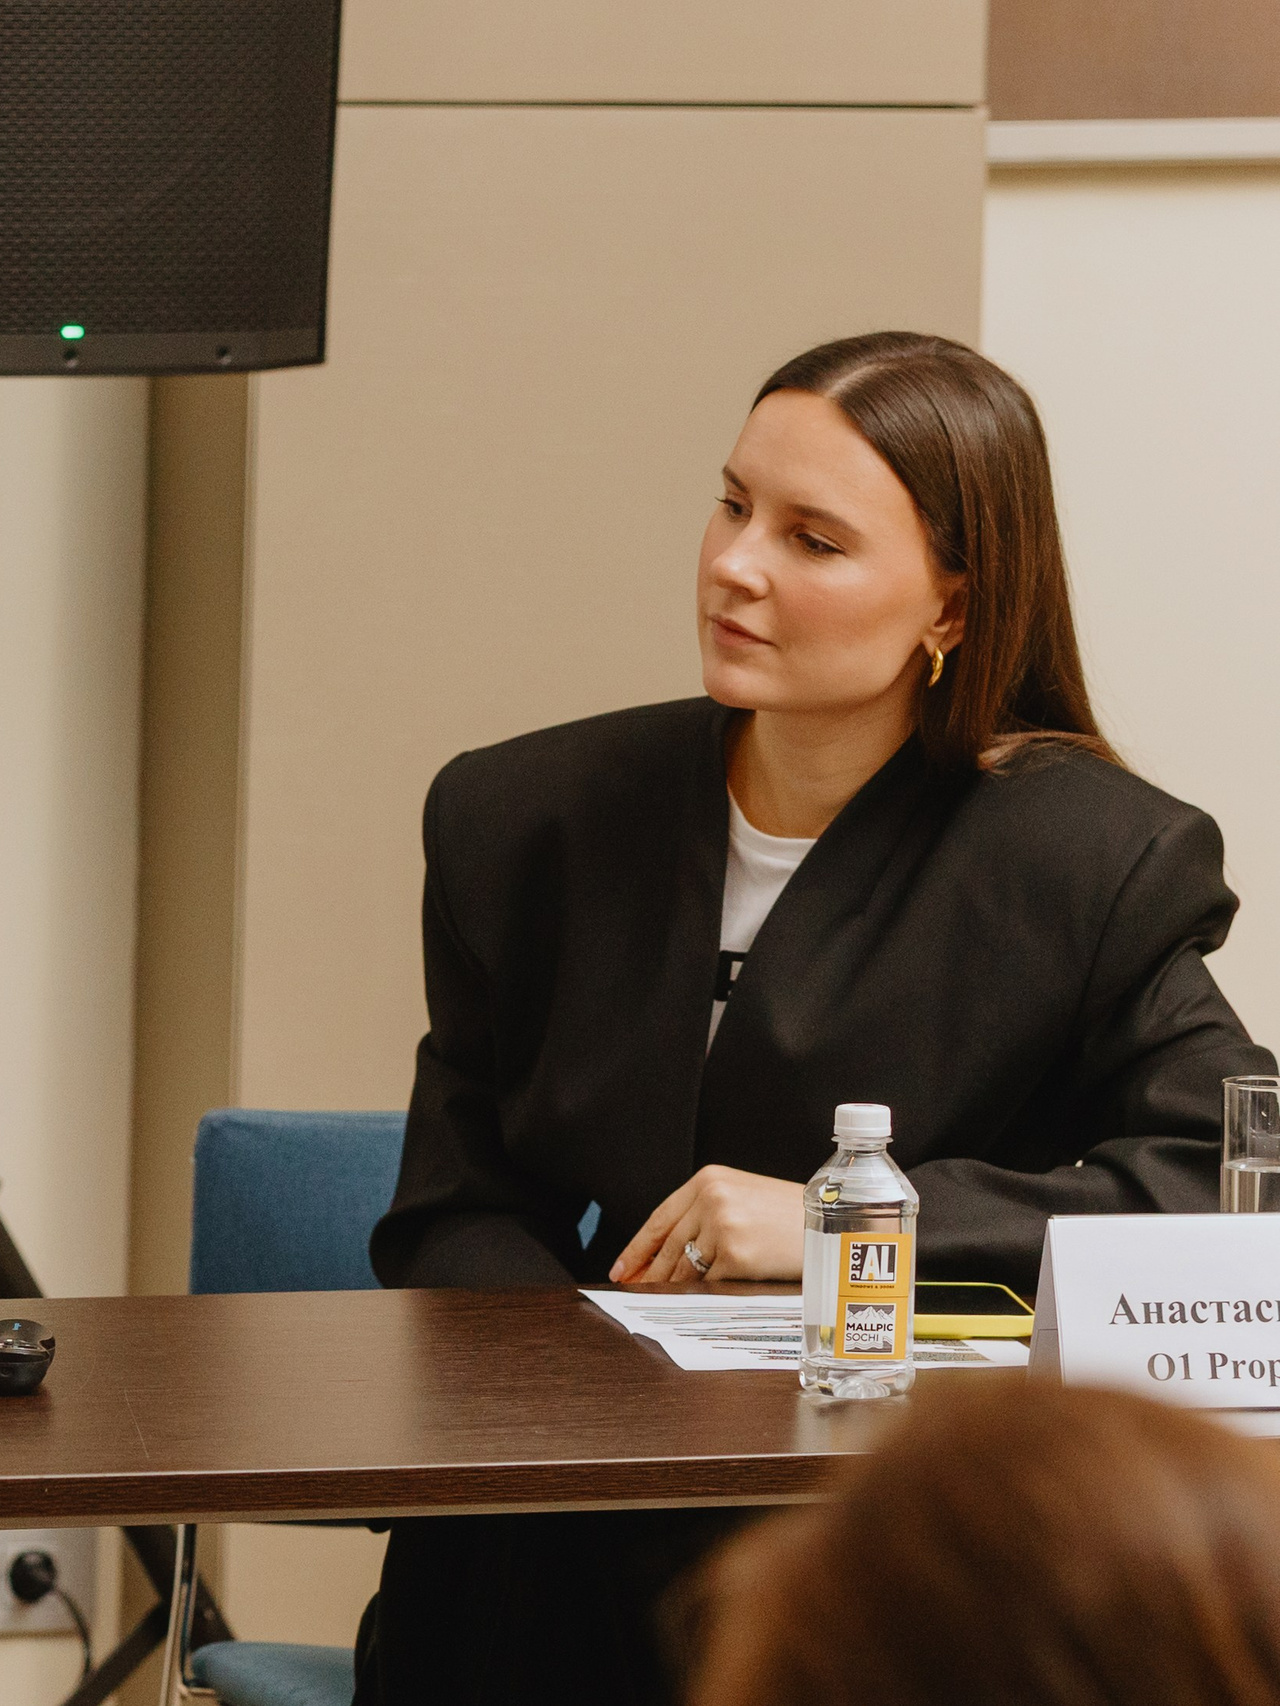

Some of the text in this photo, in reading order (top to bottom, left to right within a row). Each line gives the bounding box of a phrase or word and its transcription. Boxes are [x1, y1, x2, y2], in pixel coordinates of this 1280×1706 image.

[850, 1243, 862, 1281] PROF
[860, 1245, 894, 1280] AL
[1109, 1293, 1280, 1325] Анастас
[845, 1332, 879, 1342] SOCHI
[846, 1322, 894, 1332] MALLPIC
